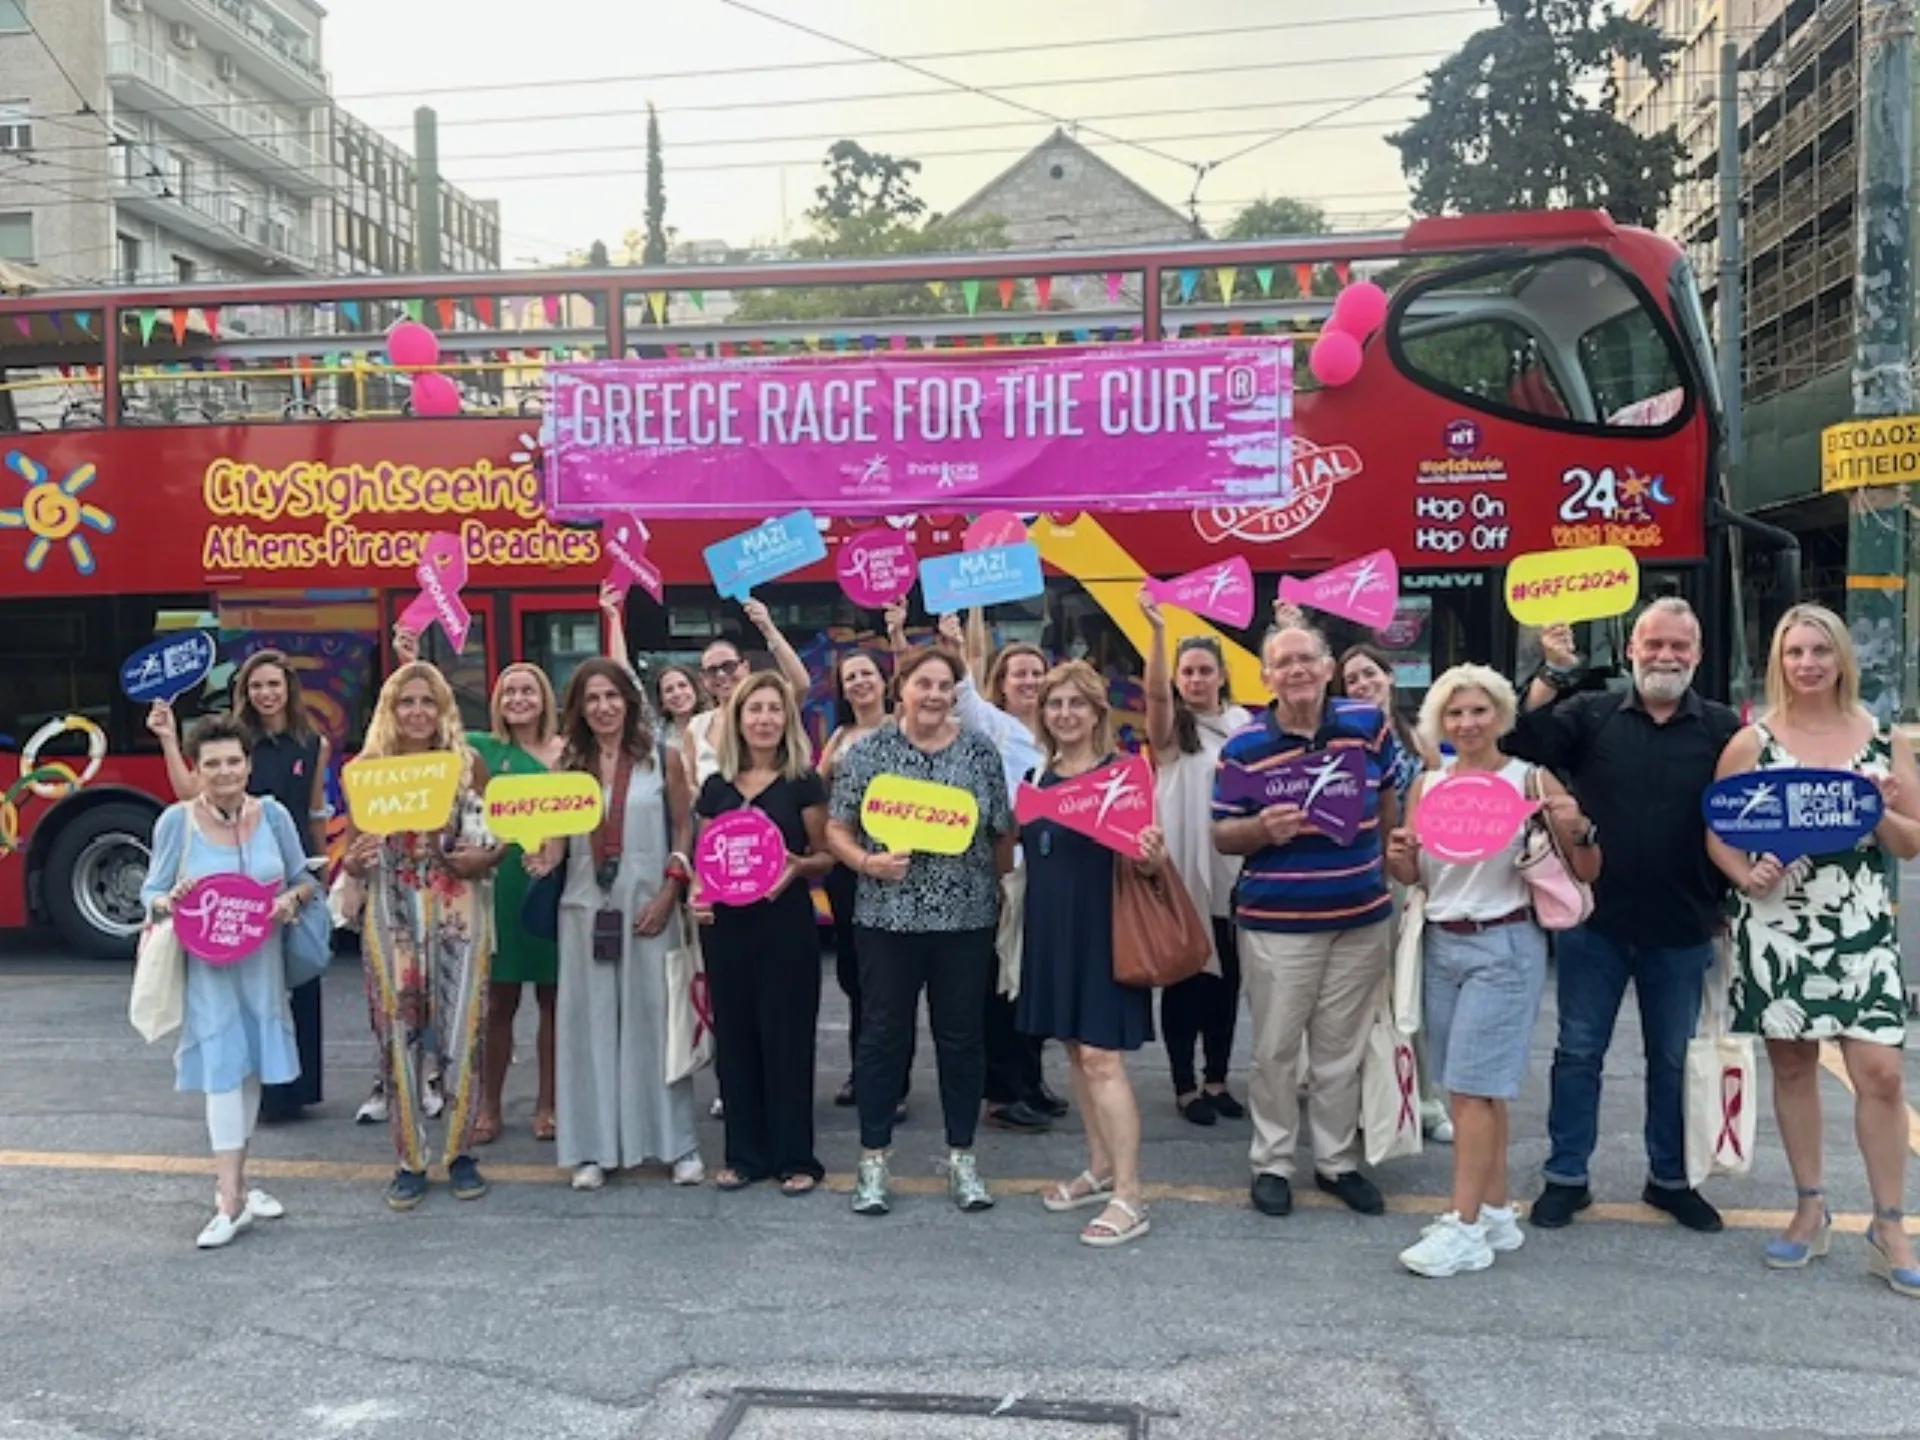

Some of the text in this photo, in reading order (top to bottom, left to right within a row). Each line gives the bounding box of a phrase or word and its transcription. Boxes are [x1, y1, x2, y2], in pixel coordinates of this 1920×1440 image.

[573, 380, 743, 448] GREECE
[759, 377, 878, 445] RACE
[893, 375, 982, 442] FOR
[997, 371, 1084, 440] THE
[1416, 493, 1505, 522] Hop On
[1560, 466, 1619, 520] 24
[1262, 493, 1321, 532] TOUR
[461, 519, 599, 564] Beaches
[1416, 525, 1510, 553] Hop Off
[1402, 572, 1484, 589] UNVI
[1511, 569, 1630, 601] #GRFC2024
[1800, 781, 1855, 797] RACE
[489, 794, 596, 818] #GRFC2024
[866, 797, 970, 828] #GRFC2024
